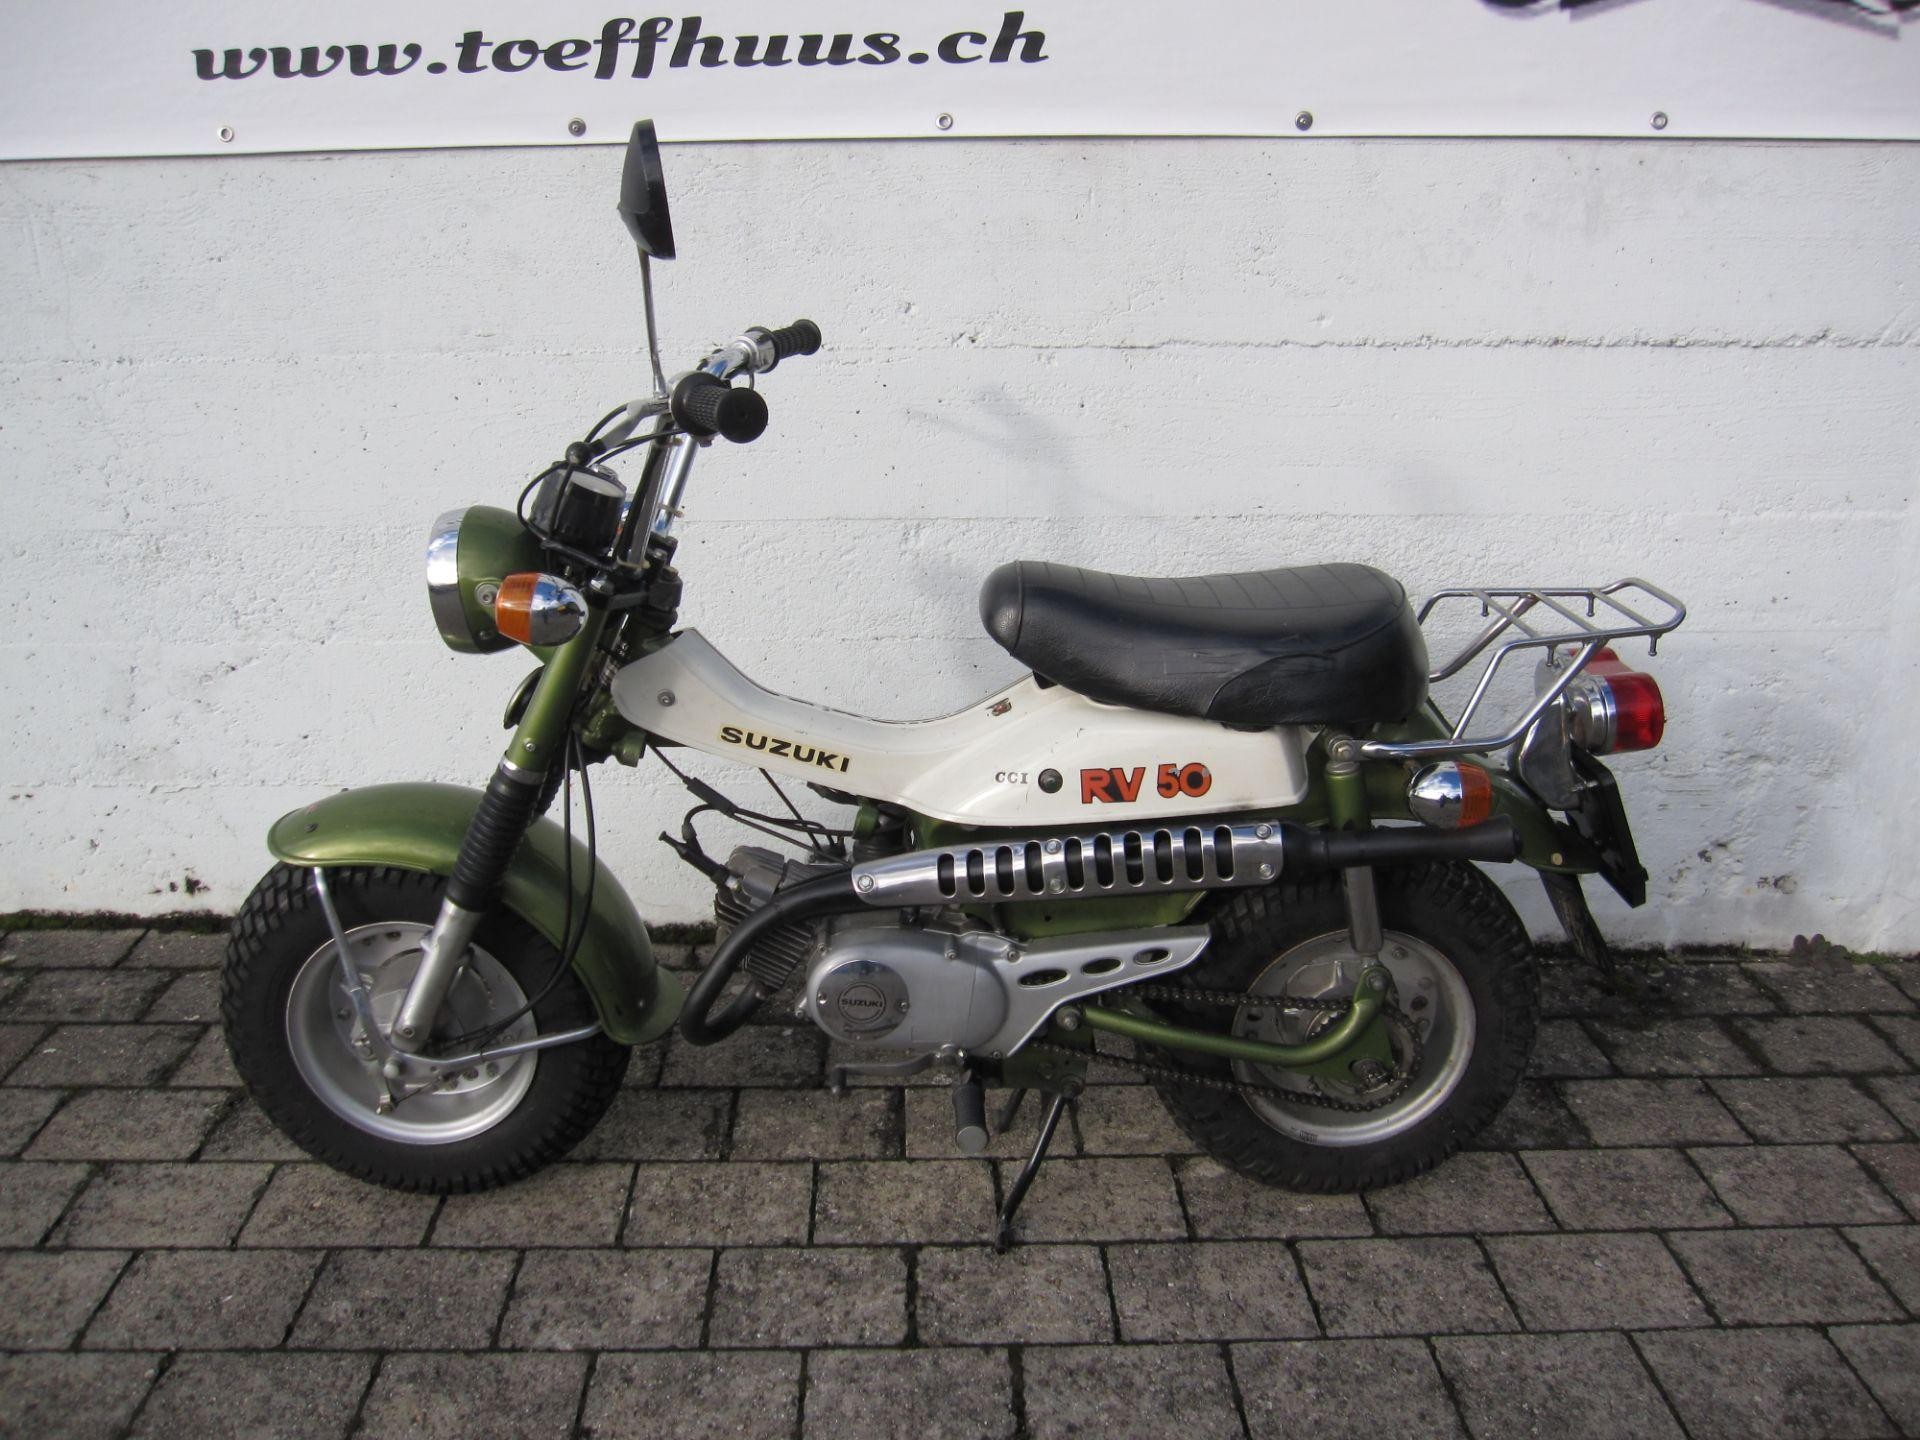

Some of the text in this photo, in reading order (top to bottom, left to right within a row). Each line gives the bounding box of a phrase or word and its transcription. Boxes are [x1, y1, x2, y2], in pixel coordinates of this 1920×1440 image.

[191, 11, 1050, 81] www.toeffhuus.ch
[720, 726, 850, 773] SUZUKI
[1080, 762, 1212, 804] RV 50
[841, 998, 883, 1008] SUZUKI
